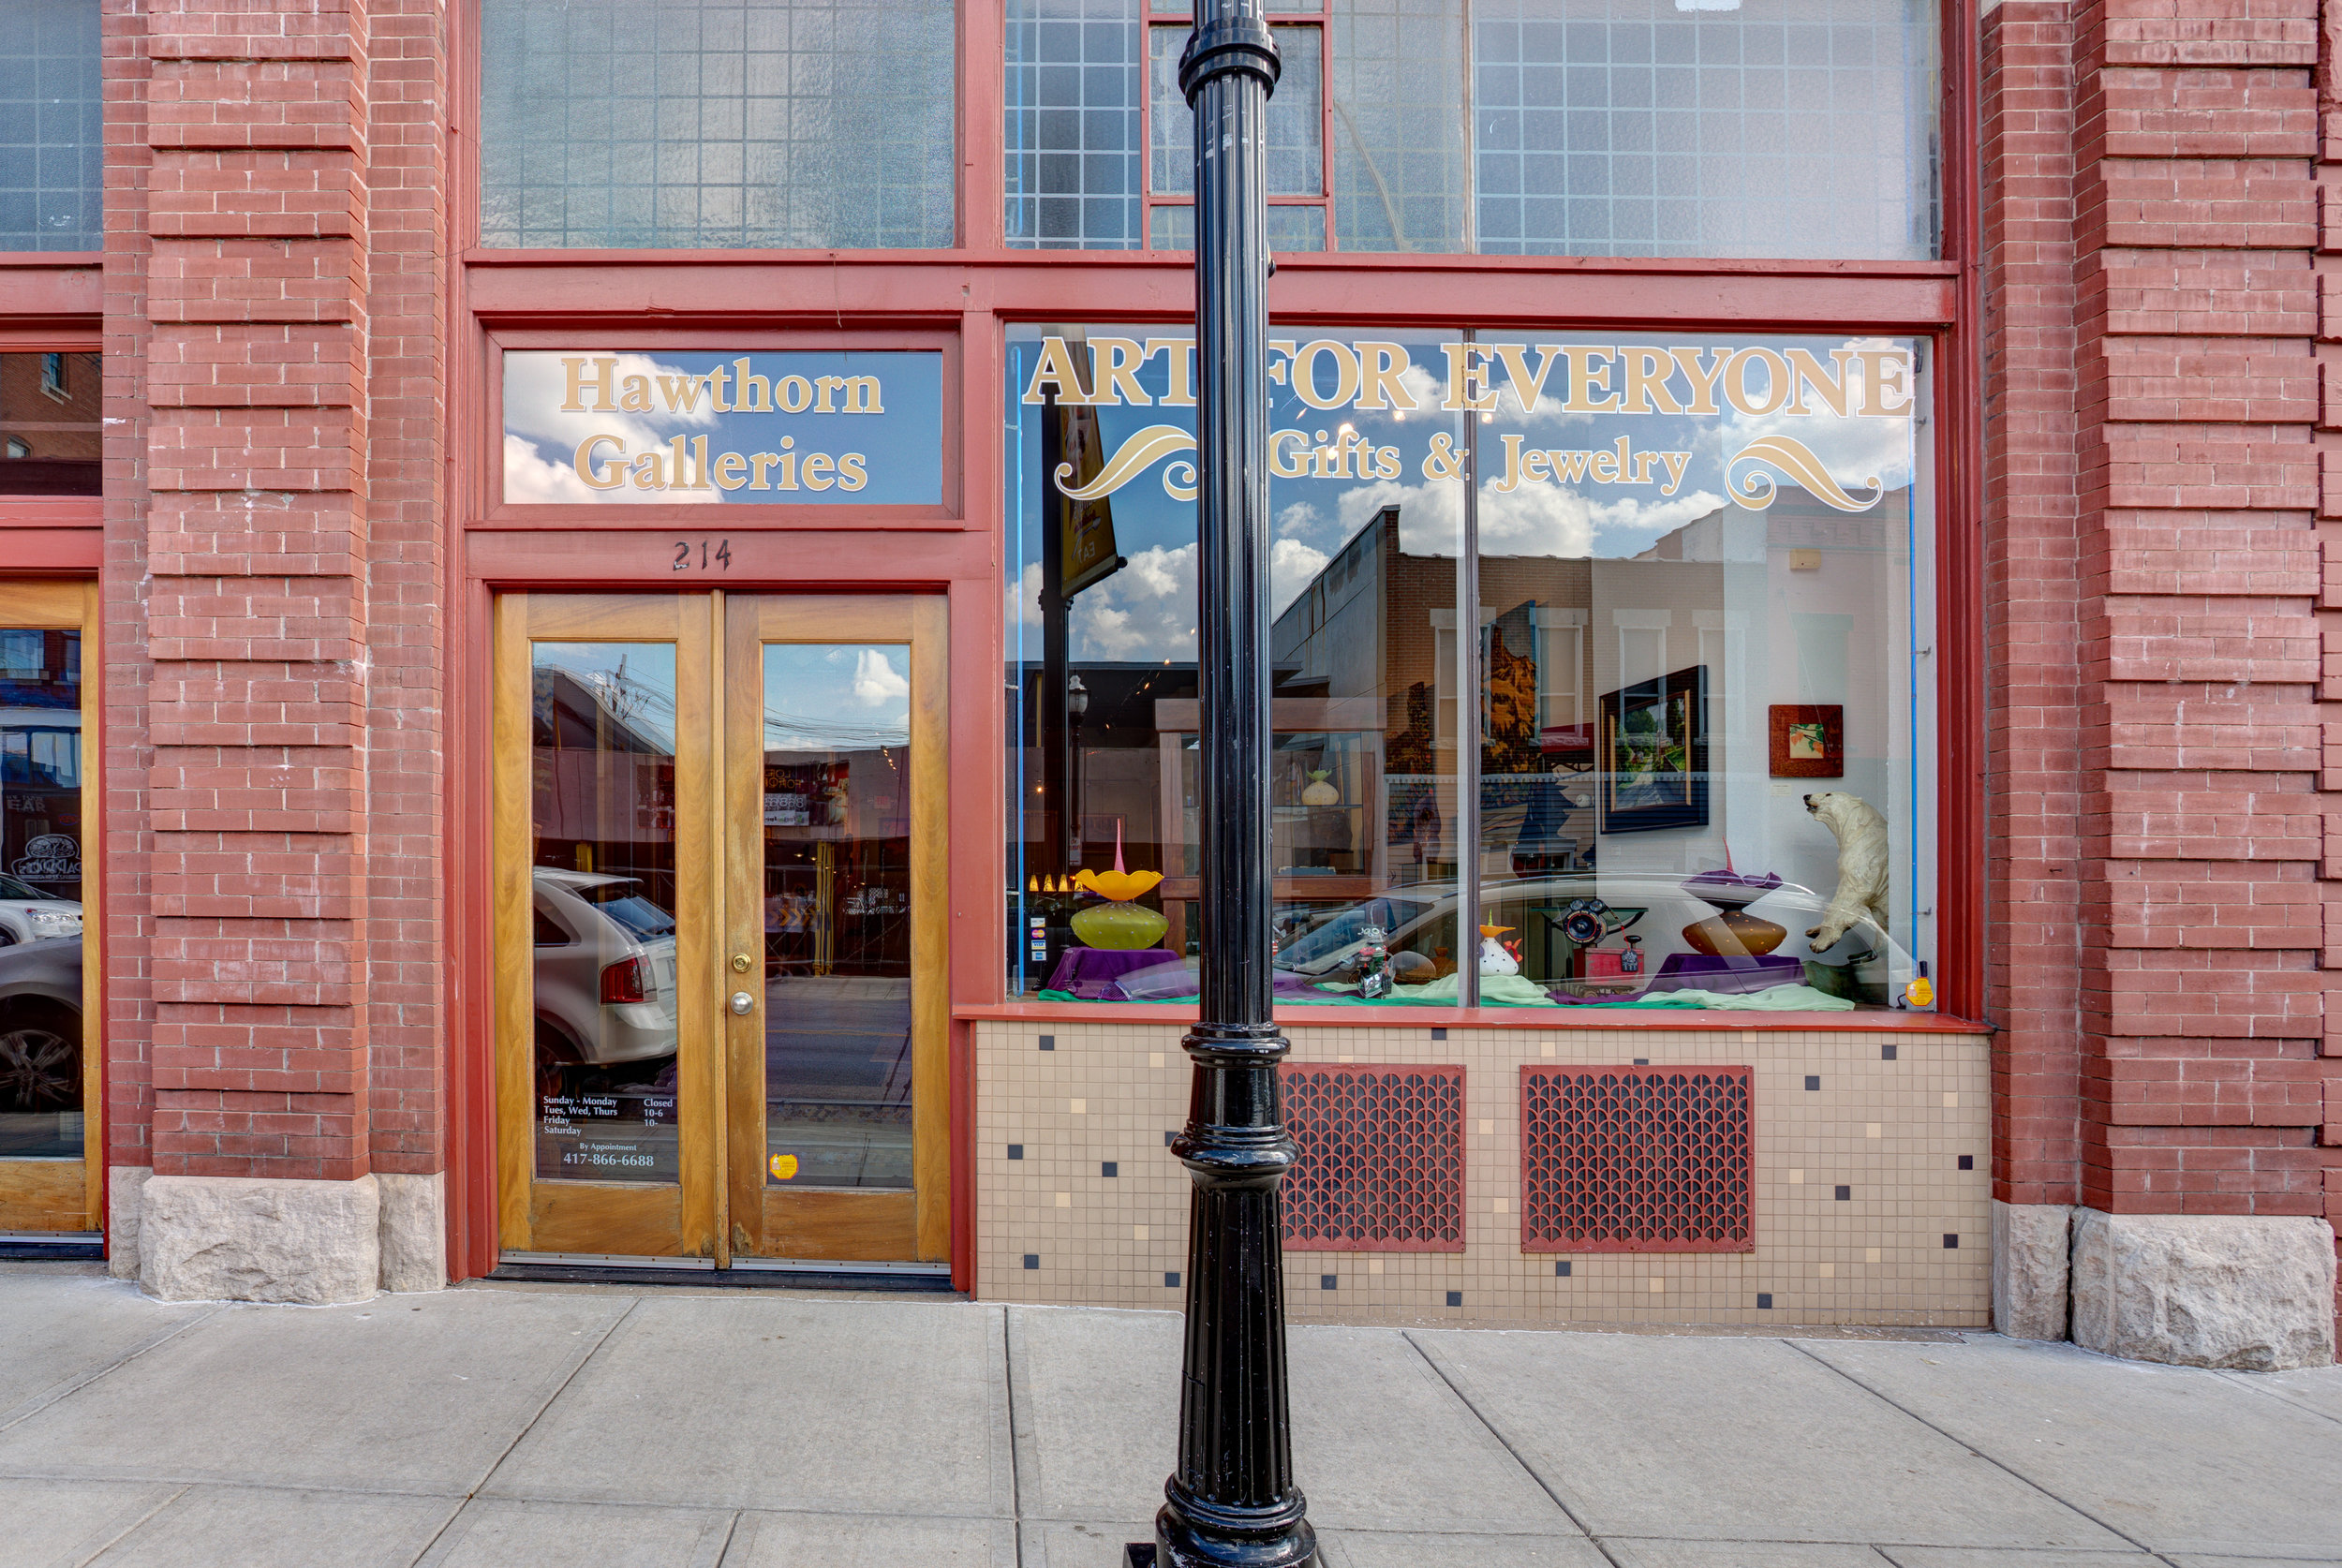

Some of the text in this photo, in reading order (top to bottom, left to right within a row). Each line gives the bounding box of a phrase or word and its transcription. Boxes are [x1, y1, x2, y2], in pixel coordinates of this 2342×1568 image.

[1022, 337, 1197, 407] ART
[1440, 342, 1916, 419] EVERYONE
[559, 357, 884, 414] Hawthorn
[573, 434, 869, 493] Galleries
[1269, 428, 1693, 496] Gifts & Jewelry
[673, 539, 731, 571] 214
[543, 1095, 574, 1106] Sunday
[583, 1097, 617, 1107] Monday
[644, 1098, 673, 1107] Closed
[544, 1106, 663, 1117] Tues, Wed, Thurs 10-6
[543, 1116, 571, 1126] Friday
[544, 1126, 582, 1136] Saturday
[579, 1143, 588, 1151] By
[564, 1153, 654, 1167] 417-866-6688
